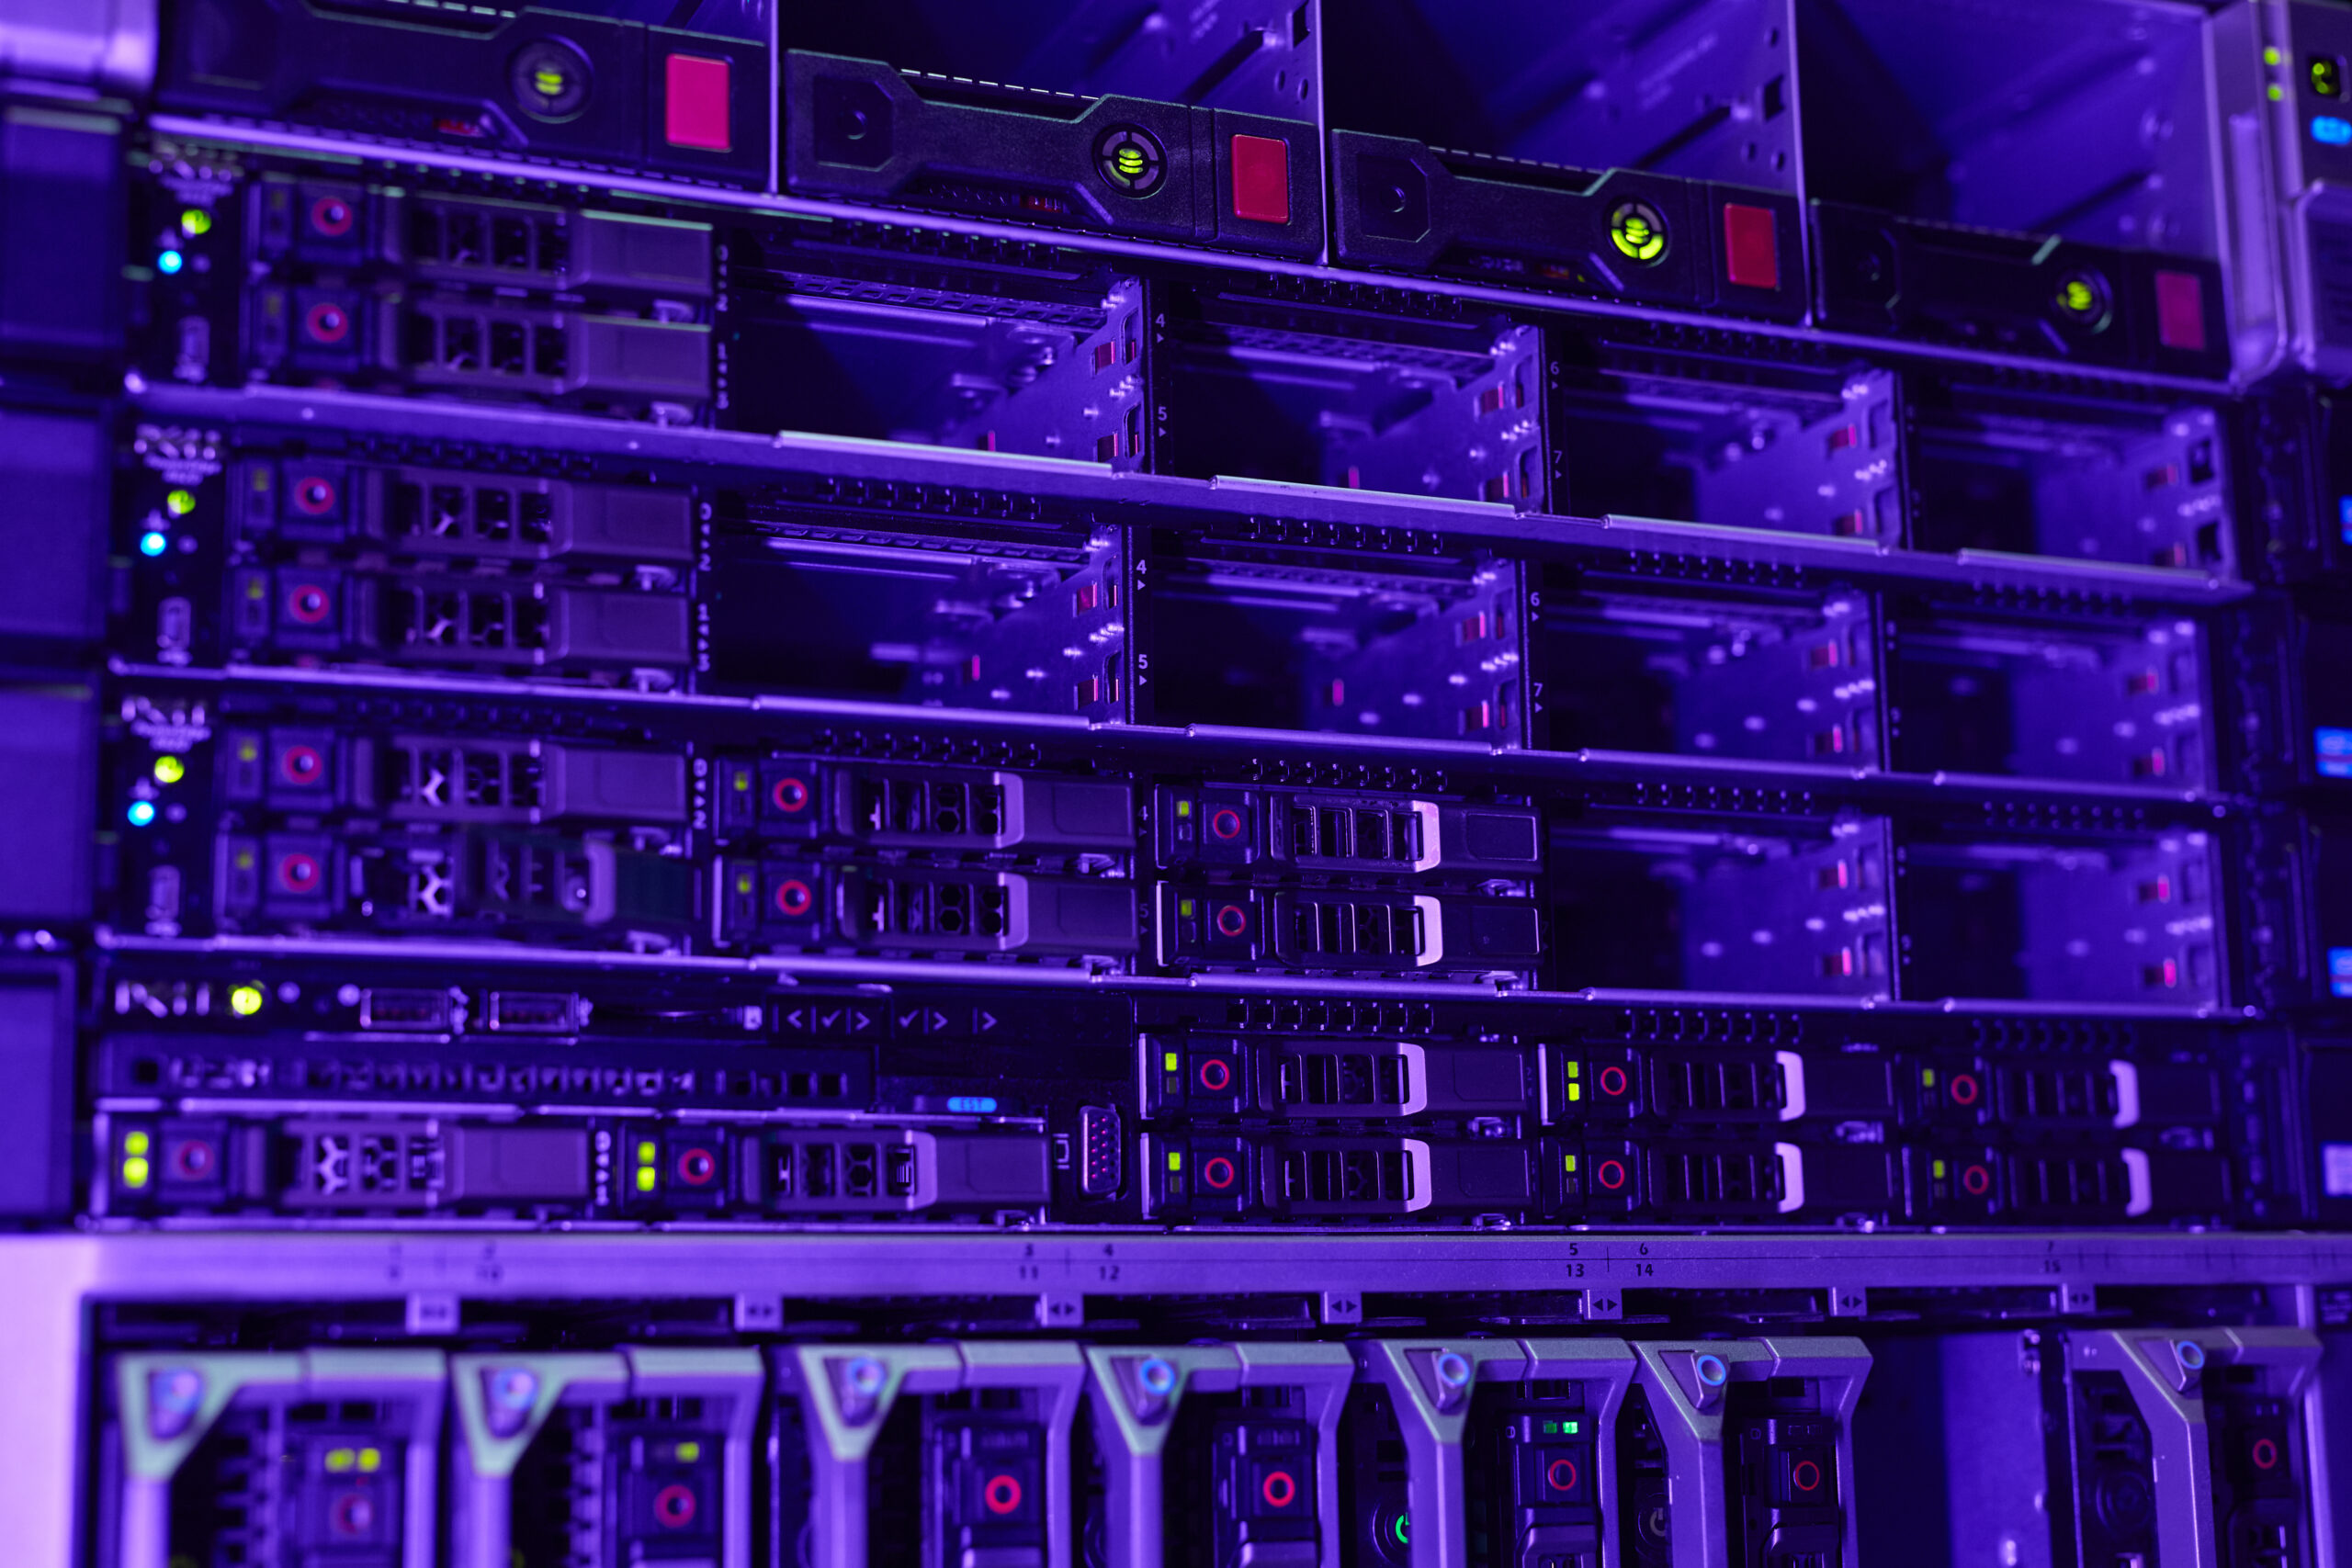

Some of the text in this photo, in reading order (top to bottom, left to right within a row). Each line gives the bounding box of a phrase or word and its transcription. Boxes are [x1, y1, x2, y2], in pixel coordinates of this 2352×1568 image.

[1155, 313, 1165, 327] 4
[1550, 361, 1559, 375] 6
[1158, 406, 1167, 420] 5
[1554, 450, 1562, 463] 7
[697, 553, 711, 571] 2
[1136, 559, 1147, 574] 4
[1530, 592, 1540, 606] 6
[1138, 654, 1148, 669] 5
[1533, 682, 1543, 696] 7
[693, 810, 707, 829] 2
[1138, 806, 1148, 820] 4
[1139, 904, 1148, 918] 5
[961, 1098, 982, 1111] EST
[1102, 1243, 1114, 1257] 4
[1569, 1243, 1578, 1256] 5
[1640, 1243, 1648, 1255] 6
[1020, 1265, 1038, 1280] 11
[1100, 1265, 1120, 1280] 12
[1566, 1263, 1584, 1277] 13
[1636, 1263, 1654, 1277] 14
[2044, 1259, 2061, 1273] 15
